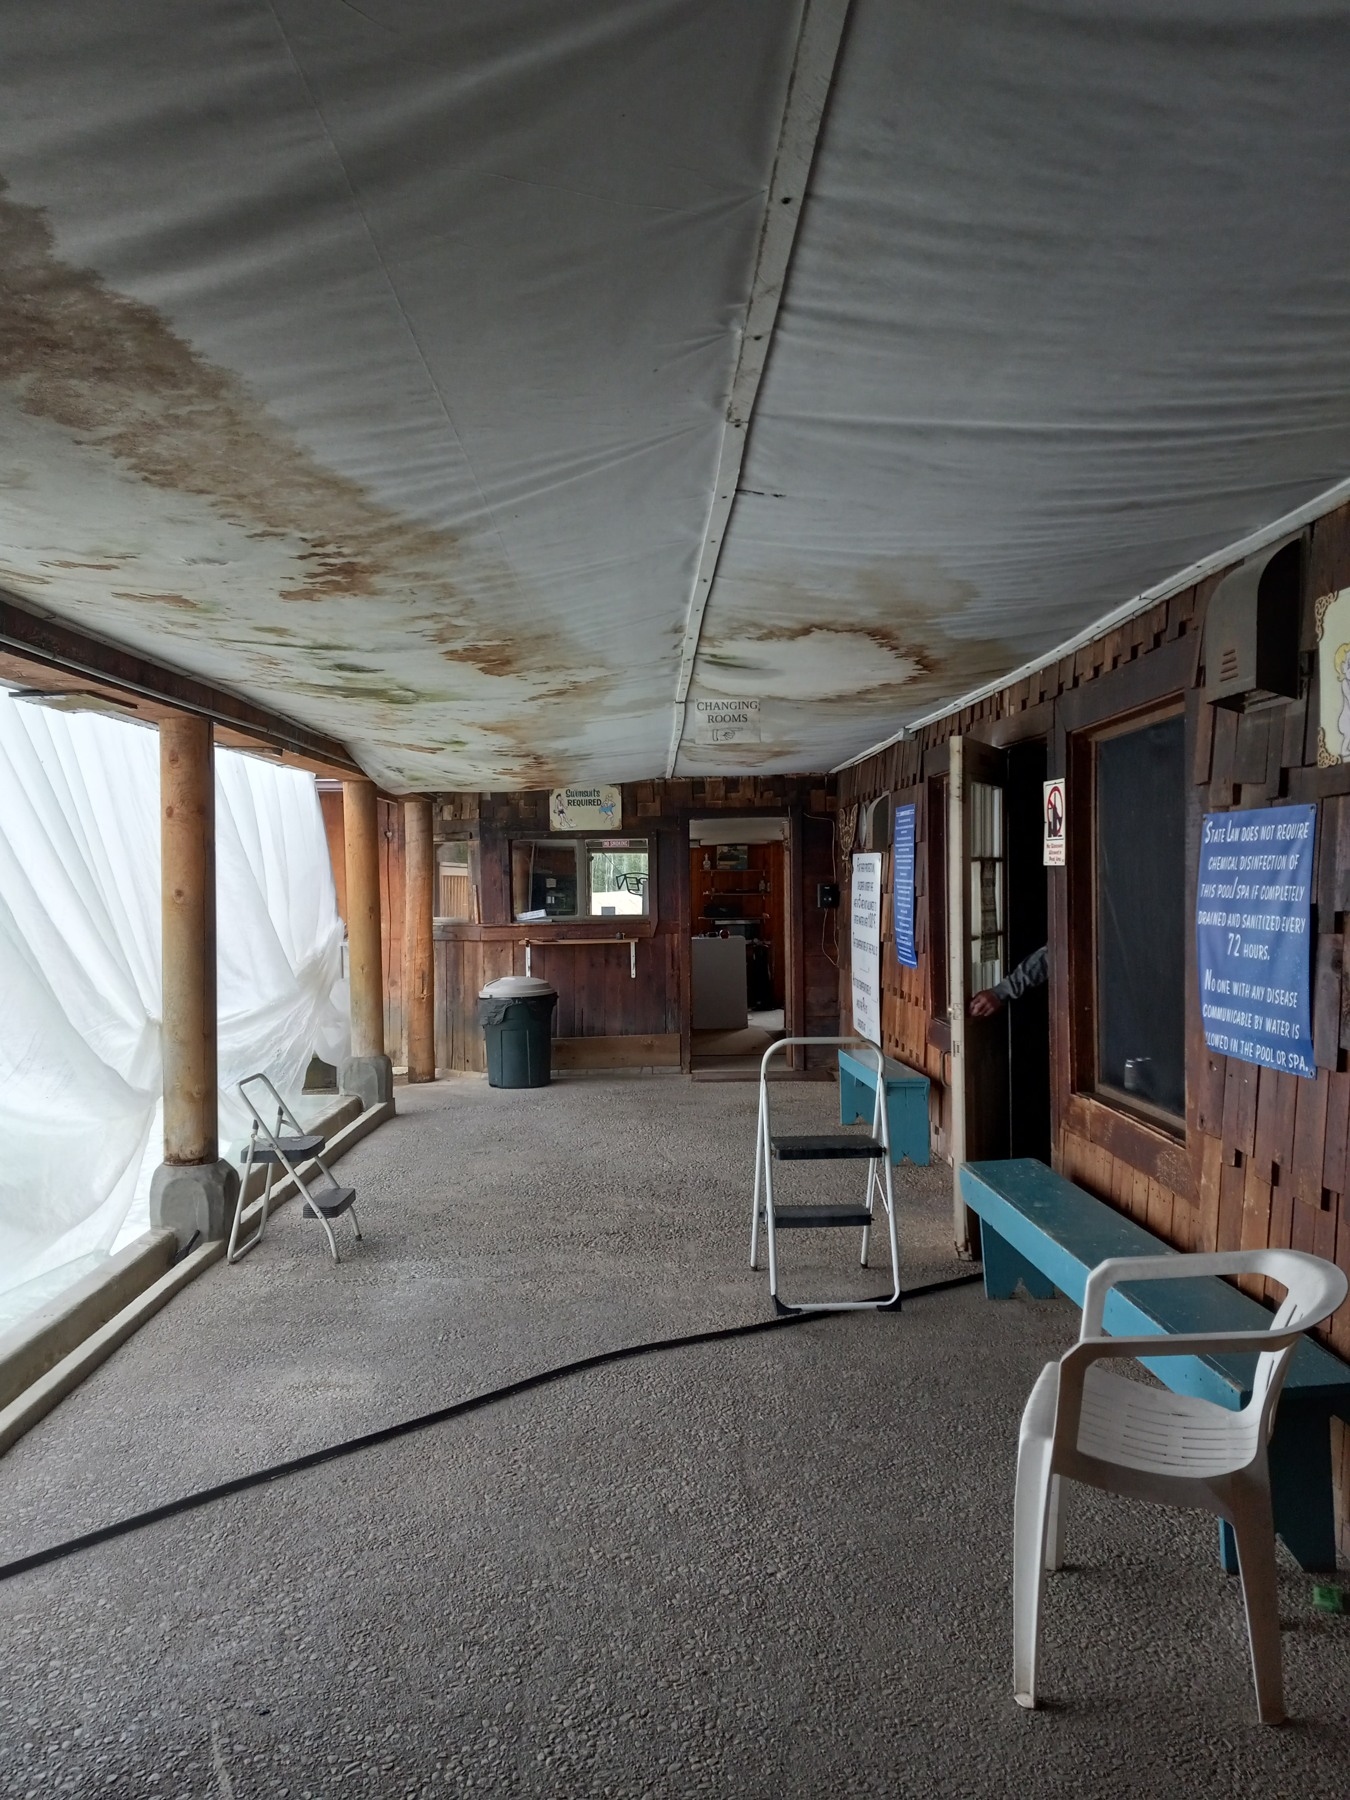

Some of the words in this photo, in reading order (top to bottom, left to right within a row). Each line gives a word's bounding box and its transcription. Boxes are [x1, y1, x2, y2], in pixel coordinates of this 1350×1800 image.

[696, 700, 758, 711] CHANGING
[707, 713, 748, 724] ROOMS
[565, 788, 601, 798] Swimsuits
[567, 798, 602, 807] REQUIRED
[1205, 821, 1225, 843] STATE
[1227, 820, 1240, 842] LAW
[1241, 826, 1259, 842] DOES
[1260, 824, 1275, 840] NOT
[1276, 822, 1310, 840] REQUIRE
[1208, 856, 1238, 871] CHEMICAL
[1240, 854, 1288, 871] DISINFECTION
[1289, 854, 1300, 869] OF
[1200, 883, 1216, 898] THIS
[1251, 885, 1260, 899] IF
[1260, 885, 1305, 901] COMPLETELY
[1198, 910, 1226, 927] DRAINED
[1227, 913, 1240, 928] AND
[1241, 914, 1280, 931] SANITIZED
[1281, 916, 1306, 934] EVERY
[1227, 933, 1241, 956] 72
[1243, 943, 1270, 960] HOURS.
[1216, 979, 1231, 995] ONE
[1232, 981, 1250, 999] WITH
[1250, 985, 1266, 1002] ANY
[1266, 988, 1298, 1008] DISEASE
[1202, 1003, 1252, 1028] COMMUNICABLE
[1254, 1015, 1264, 1030] BY
[1265, 1018, 1290, 1038] WATER
[1291, 1023, 1300, 1040] IS
[1229, 1038, 1239, 1053] IN
[1240, 1040, 1254, 1058] THE
[1255, 1044, 1274, 1063] POOL
[1276, 1049, 1287, 1068] OR
[1288, 1053, 1309, 1072] SPA.
